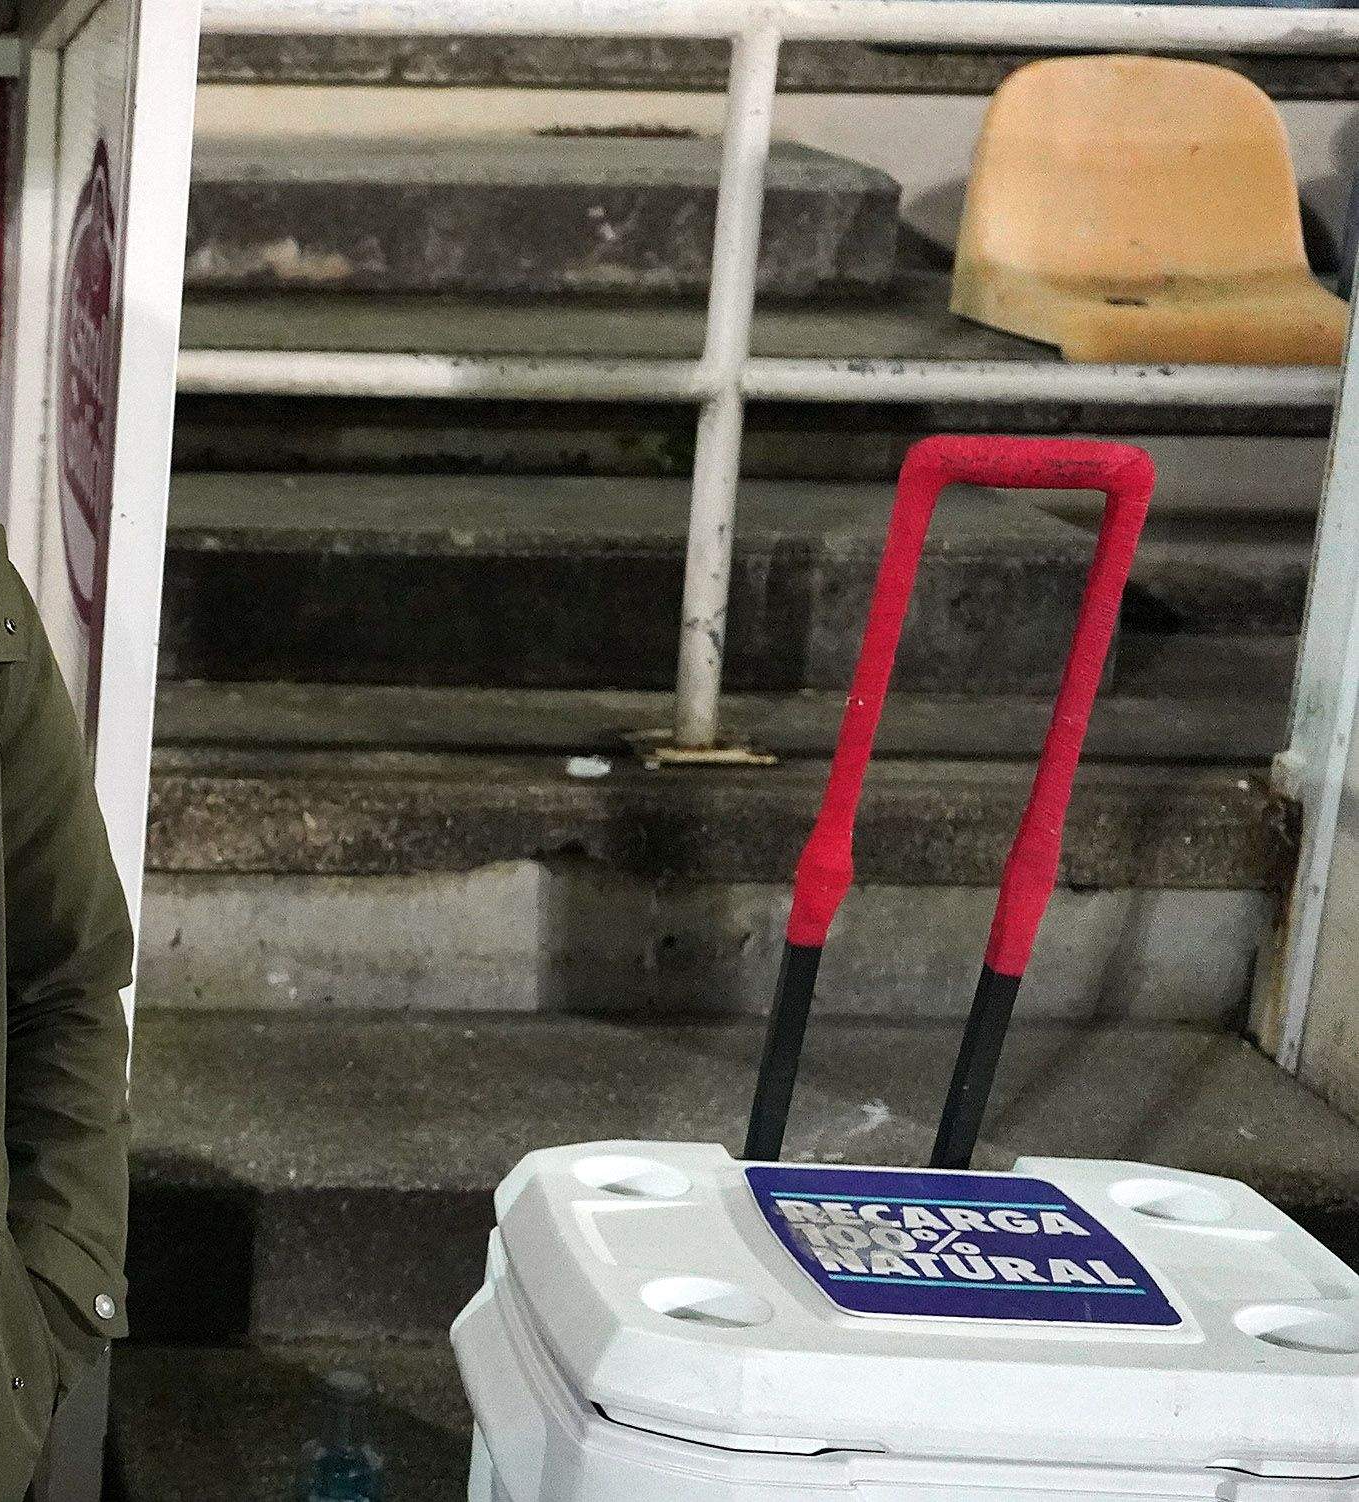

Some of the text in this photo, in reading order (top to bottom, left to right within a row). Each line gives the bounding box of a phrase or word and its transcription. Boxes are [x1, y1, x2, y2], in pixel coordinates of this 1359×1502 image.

[775, 1199, 1092, 1237] RECARGA
[793, 1222, 981, 1256] 100%
[812, 1247, 1137, 1286] NATURAL
